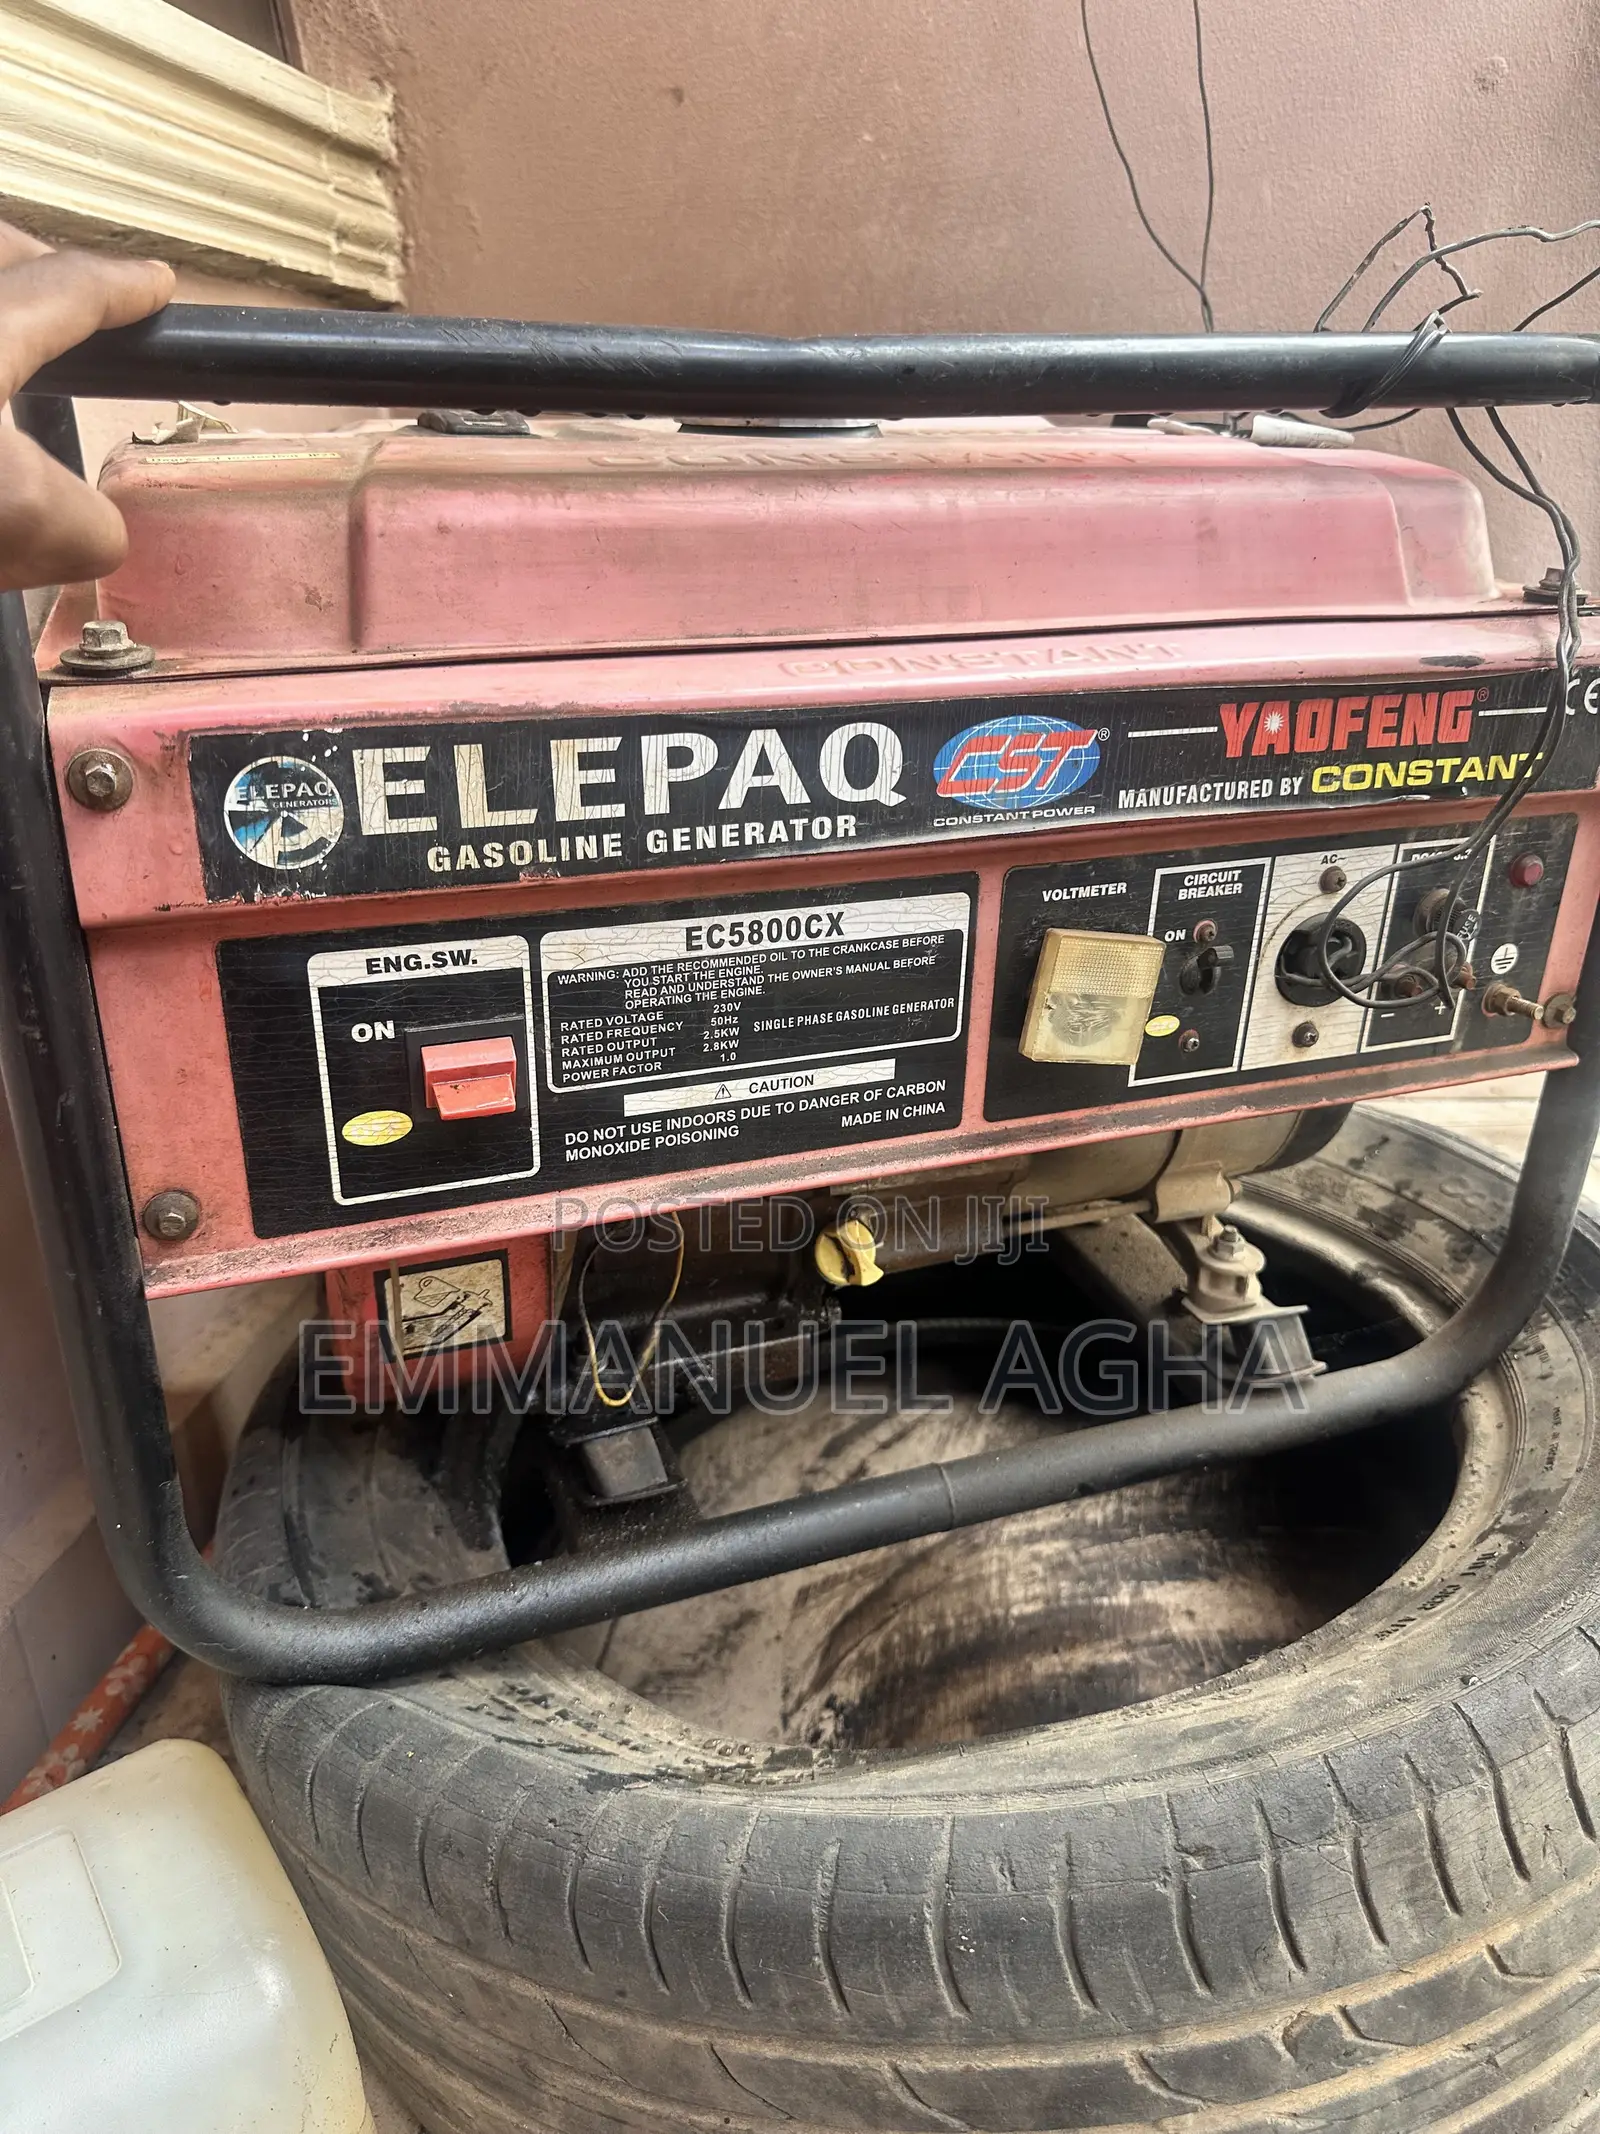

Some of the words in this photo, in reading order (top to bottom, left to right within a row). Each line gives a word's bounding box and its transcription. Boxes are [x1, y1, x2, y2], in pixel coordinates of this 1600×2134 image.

[779, 643, 1186, 678] CONSTANT
[1220, 689, 1475, 759] YAOFENG
[936, 729, 1098, 797] CST
[235, 781, 333, 800] ELEPAQ
[352, 722, 907, 835] ELEPAQ
[1118, 778, 1273, 809] MANUFACTURED
[1280, 776, 1303, 797] BY
[933, 810, 1030, 827] CONSTANT
[1032, 805, 1096, 819] POWER
[427, 833, 623, 872] GASOLINE
[646, 815, 857, 854] GENERATOR
[1042, 882, 1127, 901] VOLTMETER
[1178, 883, 1243, 900] BREAKER
[1184, 870, 1242, 887] CIRCUIT
[686, 912, 844, 951] EC5800CX
[1164, 929, 1186, 942] ON
[365, 949, 478, 974] ENG.SW.
[557, 969, 619, 985] WARNING:
[622, 967, 648, 979] ADD
[651, 963, 675, 975] THE
[677, 953, 766, 973] RECOMMENDED
[770, 952, 789, 963] OIL
[791, 948, 806, 959] TO
[809, 946, 829, 957] THE
[832, 940, 899, 955] CRANKCASE
[902, 935, 945, 948] BEFORE
[624, 977, 649, 989] YOU
[652, 973, 690, 985] START
[693, 970, 716, 981] THE
[718, 965, 763, 979] ENGINE.
[625, 988, 657, 1000] READ
[660, 984, 685, 996] AND
[688, 975, 765, 992] UNDERSTAND
[768, 972, 789, 983] THE
[792, 966, 843, 980] OWNER'S
[845, 961, 890, 974] MANUAL
[893, 956, 936, 969] BEFORE
[625, 994, 692, 1010] OPERATING
[695, 990, 717, 1002] THE
[719, 985, 765, 1000] ENGINE.
[560, 1019, 603, 1032] RATED
[606, 1011, 664, 1026] VOLTAGE
[713, 1002, 742, 1014] 230V
[561, 1032, 603, 1045] RATED
[606, 1021, 684, 1039] FREQUENCY
[710, 1015, 739, 1027] 50Hz
[754, 1015, 794, 1032] SINGLE
[797, 1012, 833, 1027] PHASE
[836, 1006, 890, 1022] GASOLINE
[892, 998, 955, 1015] GENERATOR
[351, 1020, 395, 1042] ON
[561, 1044, 603, 1058] RATED
[606, 1038, 657, 1052] OUTPUT
[703, 1027, 740, 1040] 2.5KW
[562, 1054, 623, 1070] MAXIMUM
[626, 1047, 676, 1062] OUTPUT
[703, 1040, 740, 1052] 2.8KW
[562, 1069, 609, 1083] POWER
[612, 1062, 662, 1076] FACTOR
[720, 1052, 737, 1062] 1.0
[749, 1075, 814, 1094] CAUTION
[565, 1131, 588, 1146] DO
[593, 1125, 627, 1141] NOT
[630, 1120, 662, 1136] USE
[666, 1109, 736, 1131] INDOORS
[740, 1105, 771, 1120] DUE
[775, 1101, 794, 1115] TO
[799, 1093, 859, 1111] DANGER
[863, 1088, 882, 1102] OF
[886, 1080, 946, 1098] CARBON
[841, 1110, 882, 1128] MADE
[885, 1109, 899, 1121] IN
[902, 1101, 946, 1118] CHINA
[565, 1138, 650, 1162] MONOXIDE
[654, 1125, 739, 1148] POISONING
